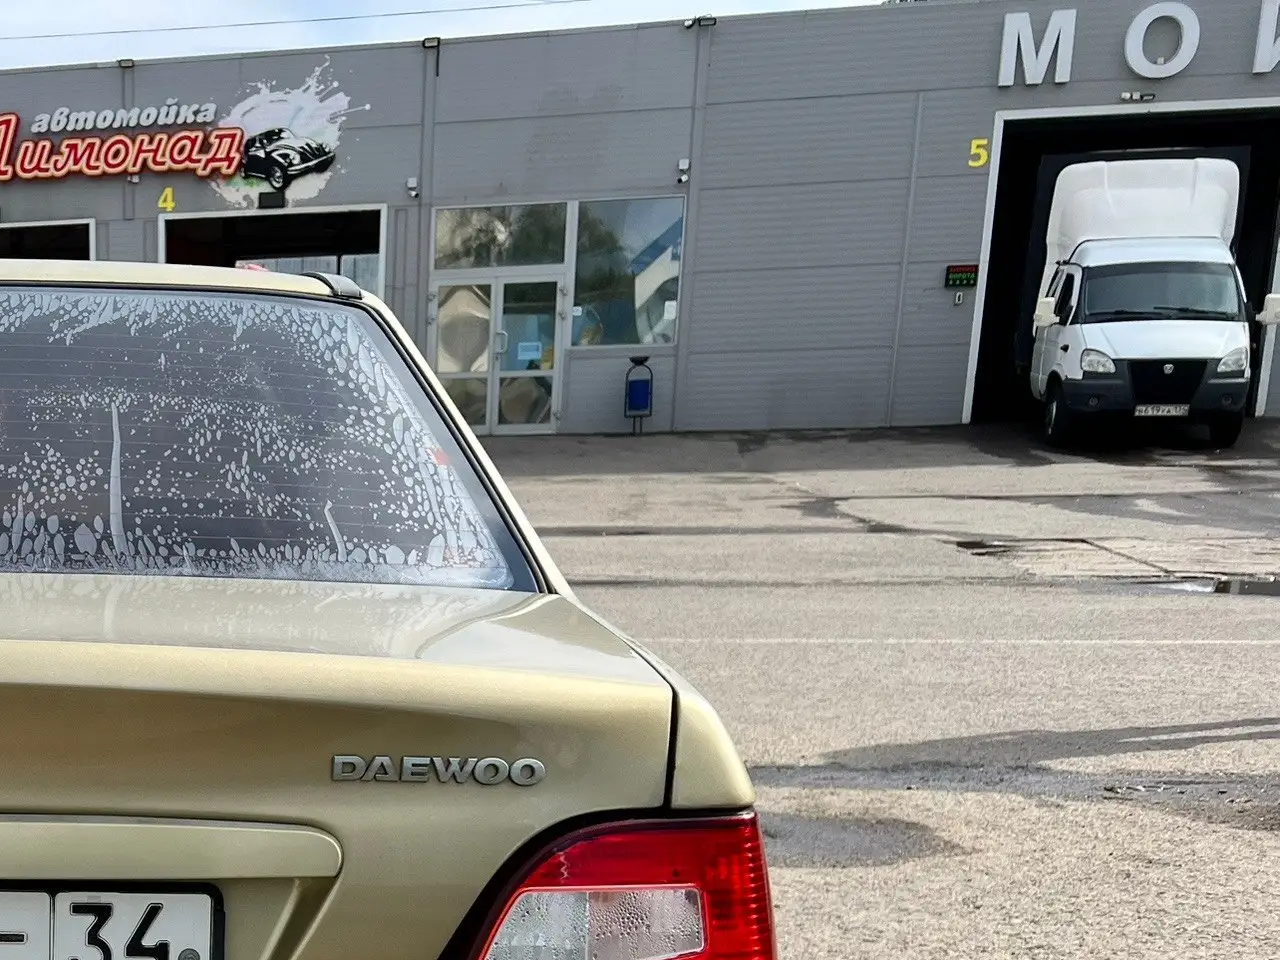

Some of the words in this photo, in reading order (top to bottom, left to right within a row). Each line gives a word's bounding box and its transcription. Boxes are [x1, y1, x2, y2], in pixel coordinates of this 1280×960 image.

[30, 97, 218, 133] автомойка
[968, 138, 989, 168] 5
[158, 187, 176, 212] 4
[331, 755, 546, 786] DAEWOO
